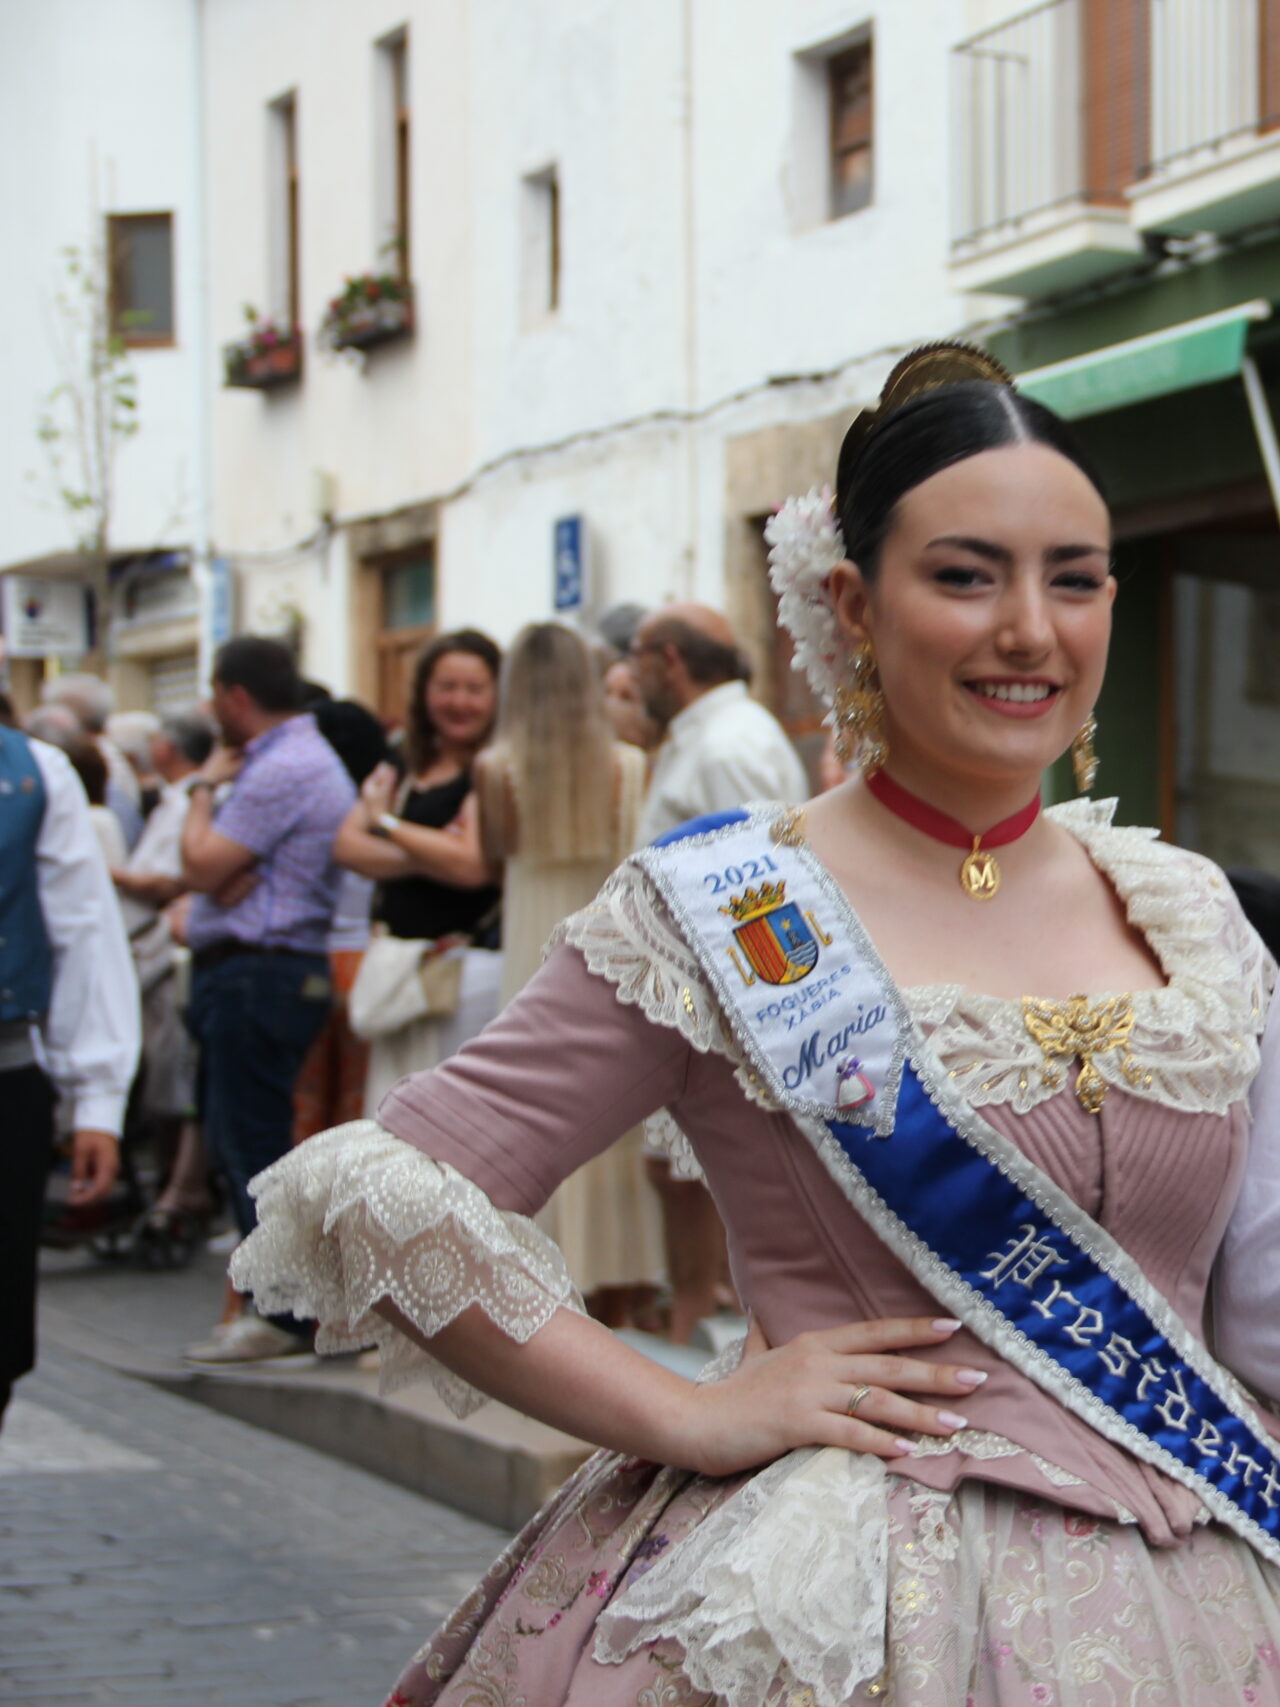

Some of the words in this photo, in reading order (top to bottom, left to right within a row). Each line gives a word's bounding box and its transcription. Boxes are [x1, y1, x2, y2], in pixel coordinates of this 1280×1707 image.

[704, 853, 778, 894] 2021
[969, 861, 995, 891] M
[782, 1003, 887, 1090] Maria
